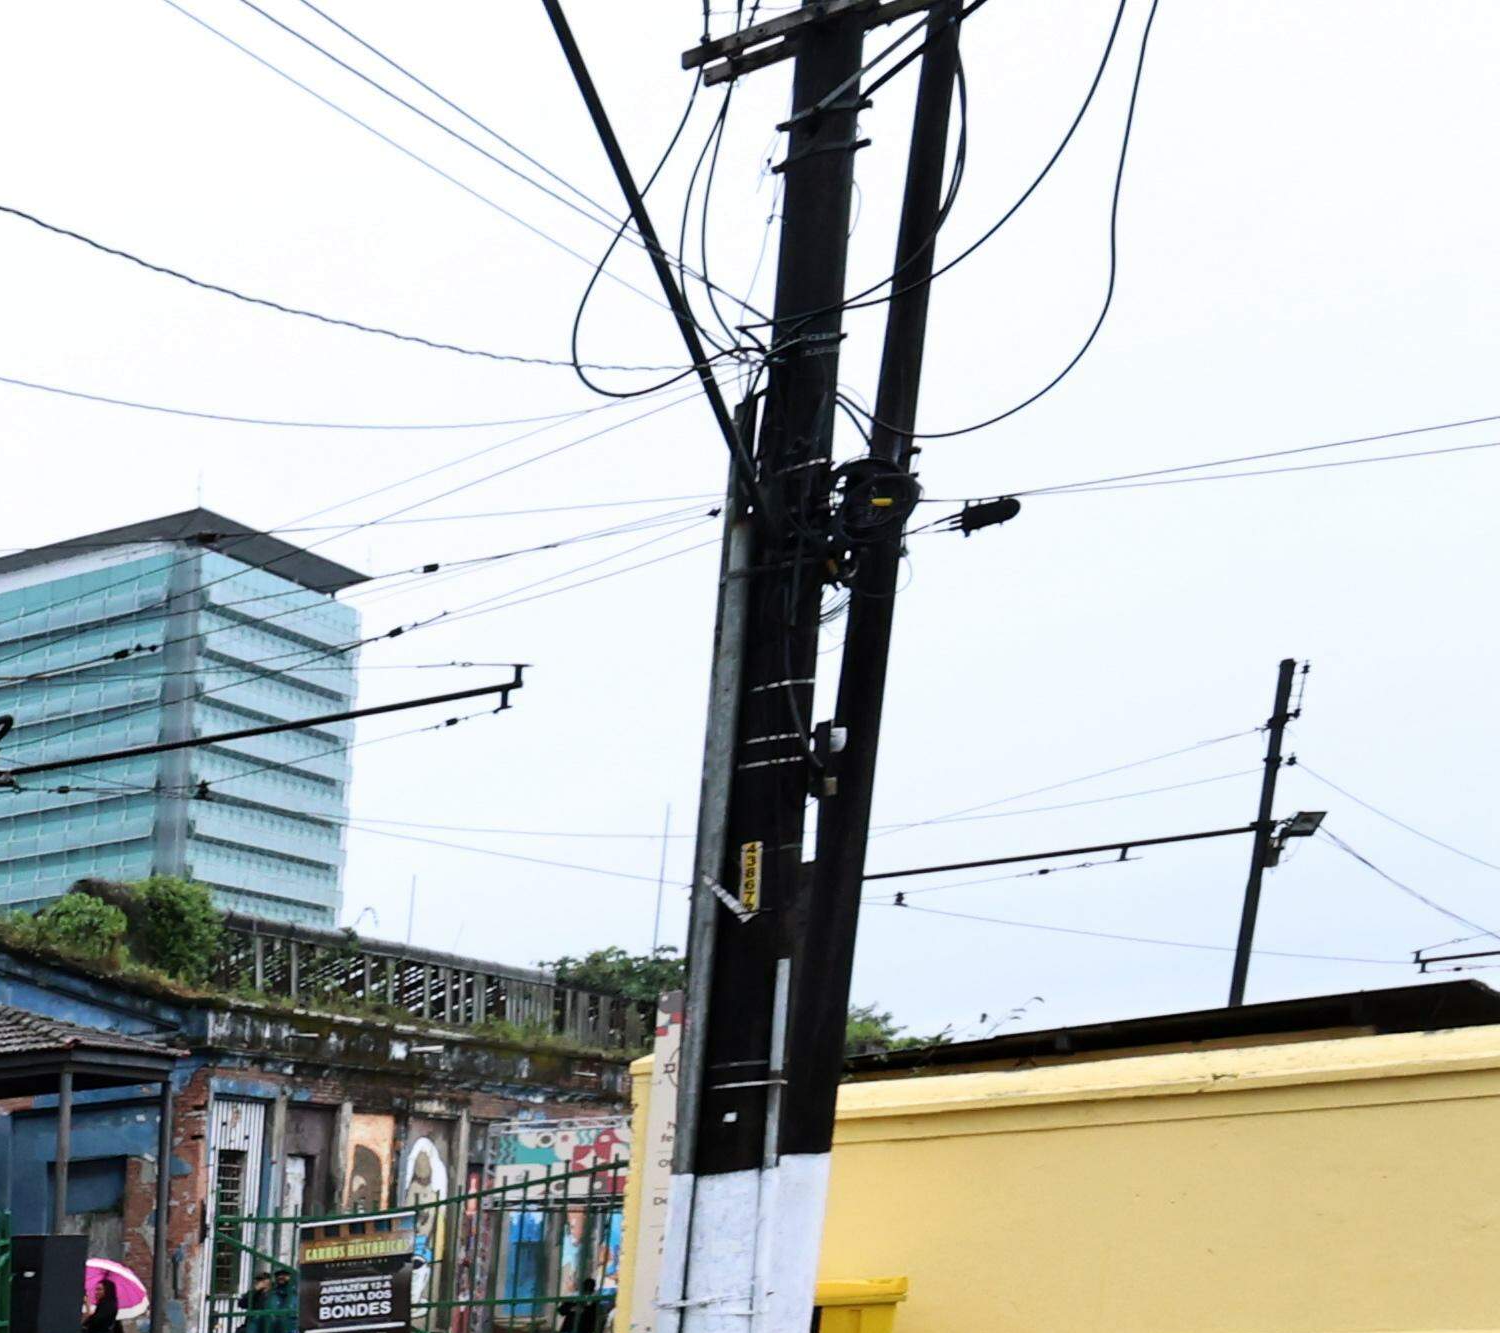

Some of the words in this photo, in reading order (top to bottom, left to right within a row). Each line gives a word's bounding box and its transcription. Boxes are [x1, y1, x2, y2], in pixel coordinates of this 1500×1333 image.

[319, 1292, 366, 1304] OFICINA
[367, 1290, 392, 1300] DOS
[319, 1301, 392, 1320] BONDES
